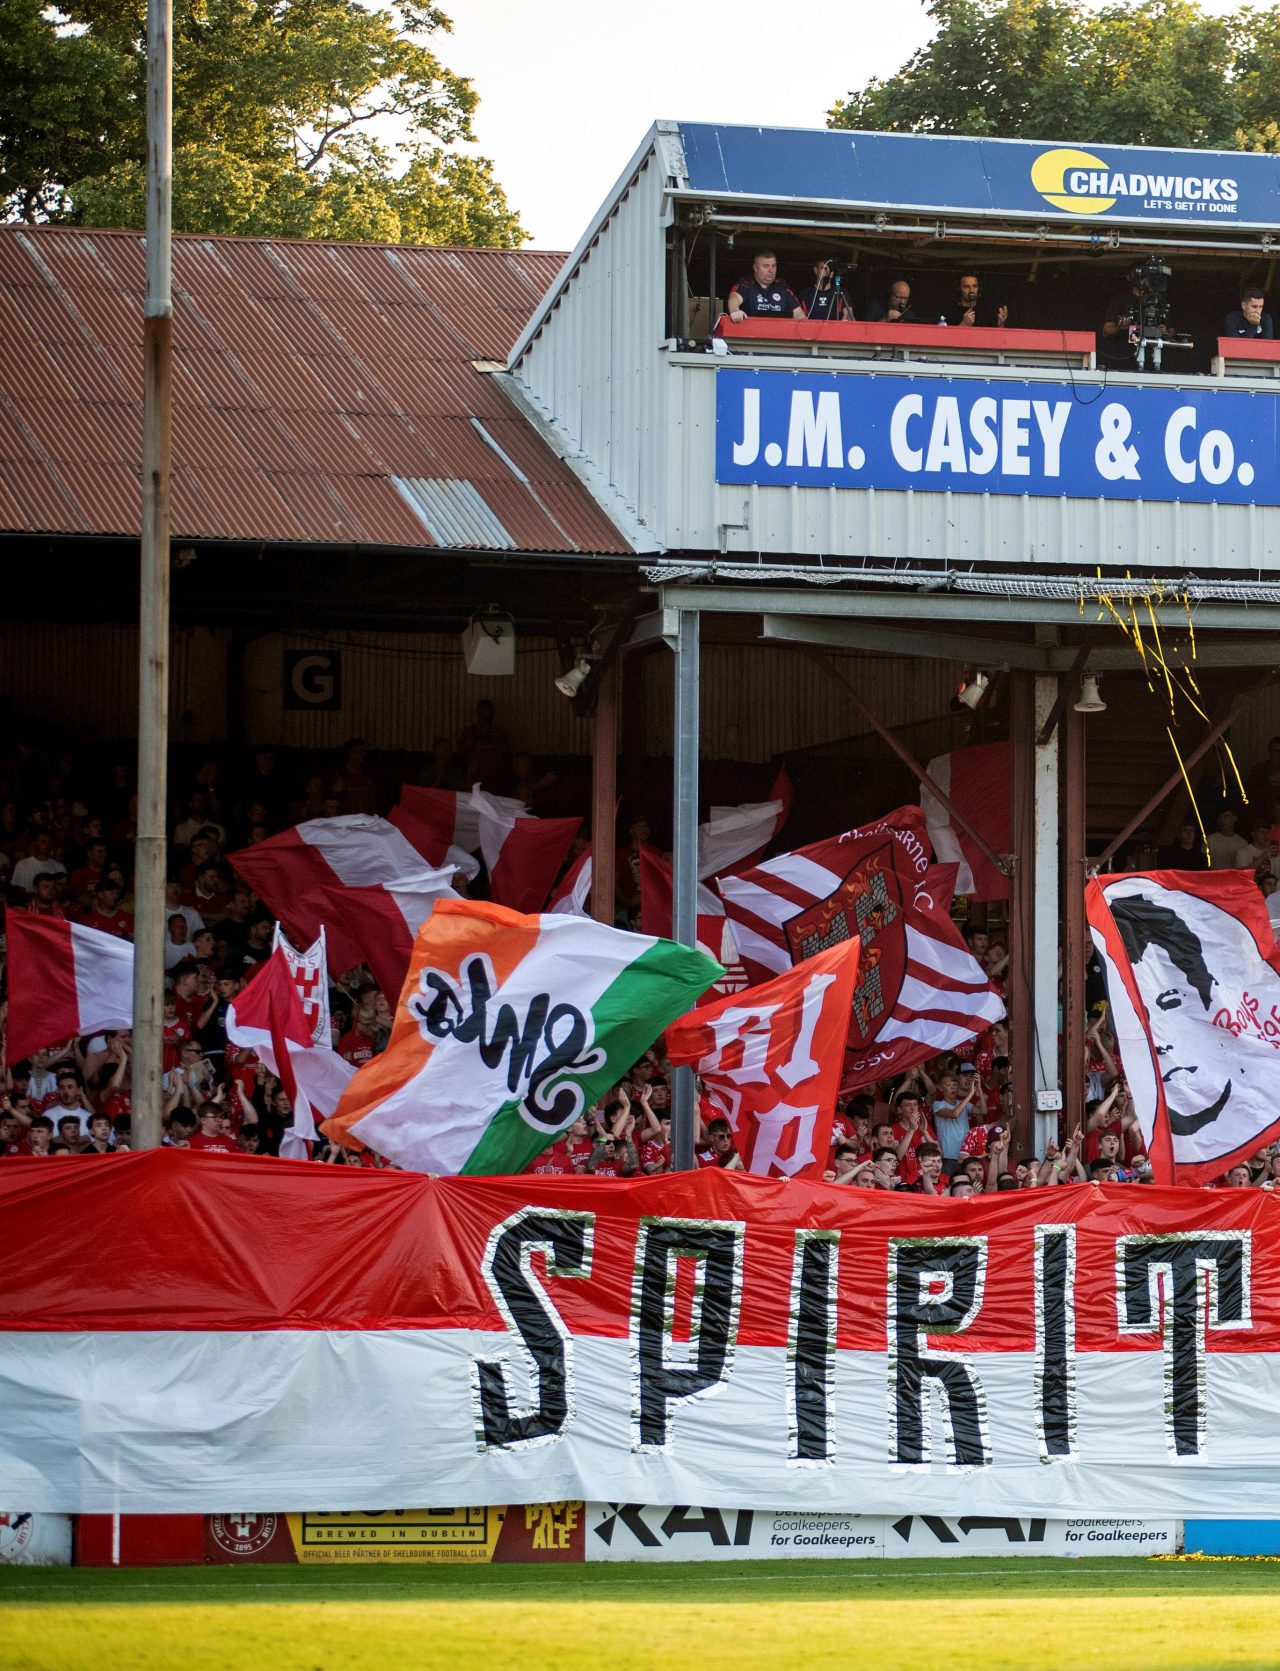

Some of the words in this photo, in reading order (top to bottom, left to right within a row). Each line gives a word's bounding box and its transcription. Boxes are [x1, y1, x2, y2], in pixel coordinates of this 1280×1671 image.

[1069, 171, 1239, 202] CHADWICKS
[1143, 199, 1173, 210] LET'S
[1174, 201, 1196, 211] GET
[1197, 202, 1207, 211] IT
[1208, 203, 1238, 213] DONE
[732, 388, 866, 470] J.M.
[890, 393, 1073, 477] CASEY
[1094, 402, 1142, 481] &
[1164, 405, 1256, 487] Co.
[290, 657, 335, 704] G
[1212, 991, 1262, 1037] Boys
[470, 1205, 1254, 1475] SPIRIT
[316, 1530, 378, 1538] BREWED
[391, 1530, 407, 1538] IN
[421, 1529, 476, 1538] DUBLIN
[532, 1523, 571, 1549] ALE
[772, 1519, 853, 1533] Goalkeepers,
[770, 1534, 791, 1546] for
[793, 1533, 876, 1548] Goalkeepers
[1065, 1530, 1085, 1542] for
[1087, 1529, 1168, 1544] Goalkeepers
[303, 1550, 330, 1558] OFFICIAL
[334, 1550, 351, 1558] BEER
[352, 1549, 382, 1558] PARTNER
[392, 1549, 436, 1558] SHELBOURNE
[437, 1549, 469, 1558] FOOTBALL
[470, 1549, 488, 1558] CLUB
